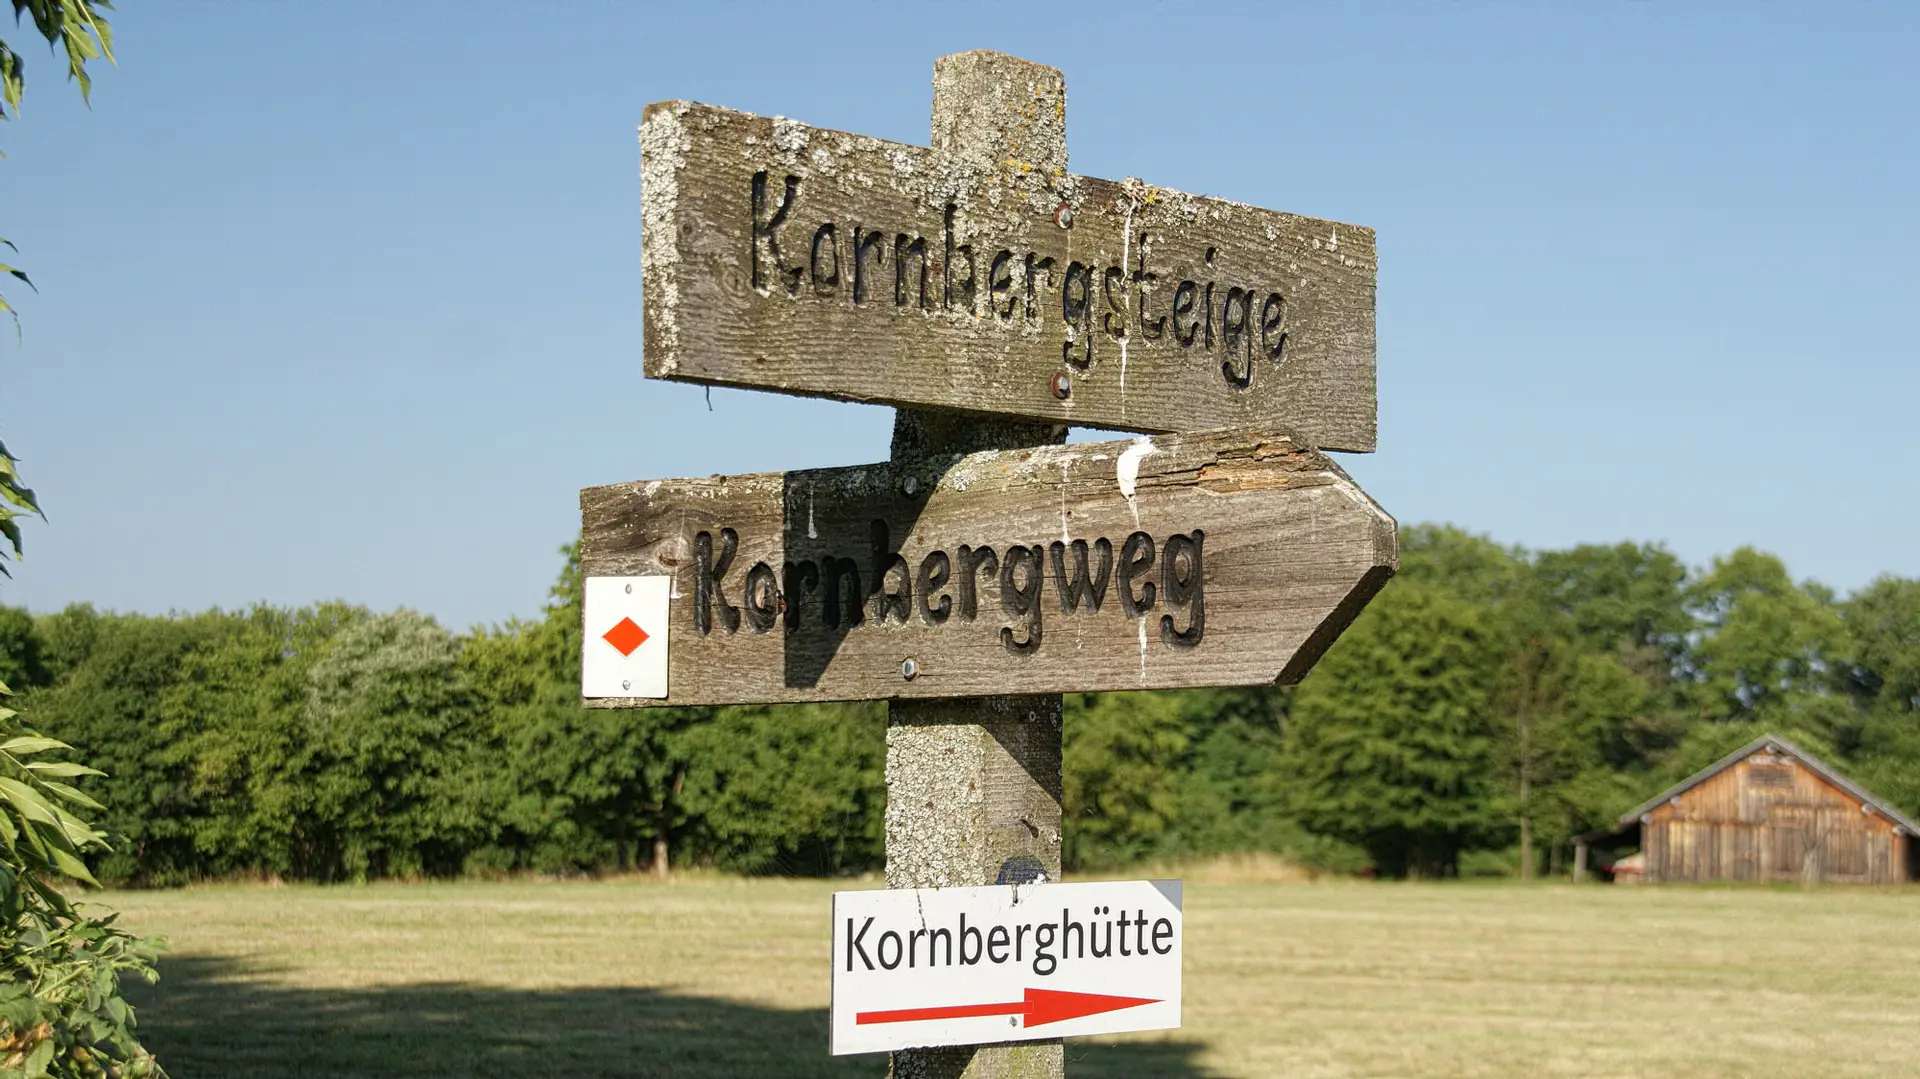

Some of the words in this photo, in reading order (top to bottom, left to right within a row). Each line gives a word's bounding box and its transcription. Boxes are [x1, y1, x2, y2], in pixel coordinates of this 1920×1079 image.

[752, 171, 1289, 389] Kornbergsteige
[693, 518, 1205, 654] Kornbergweg
[846, 906, 1174, 976] Kornberghütte
